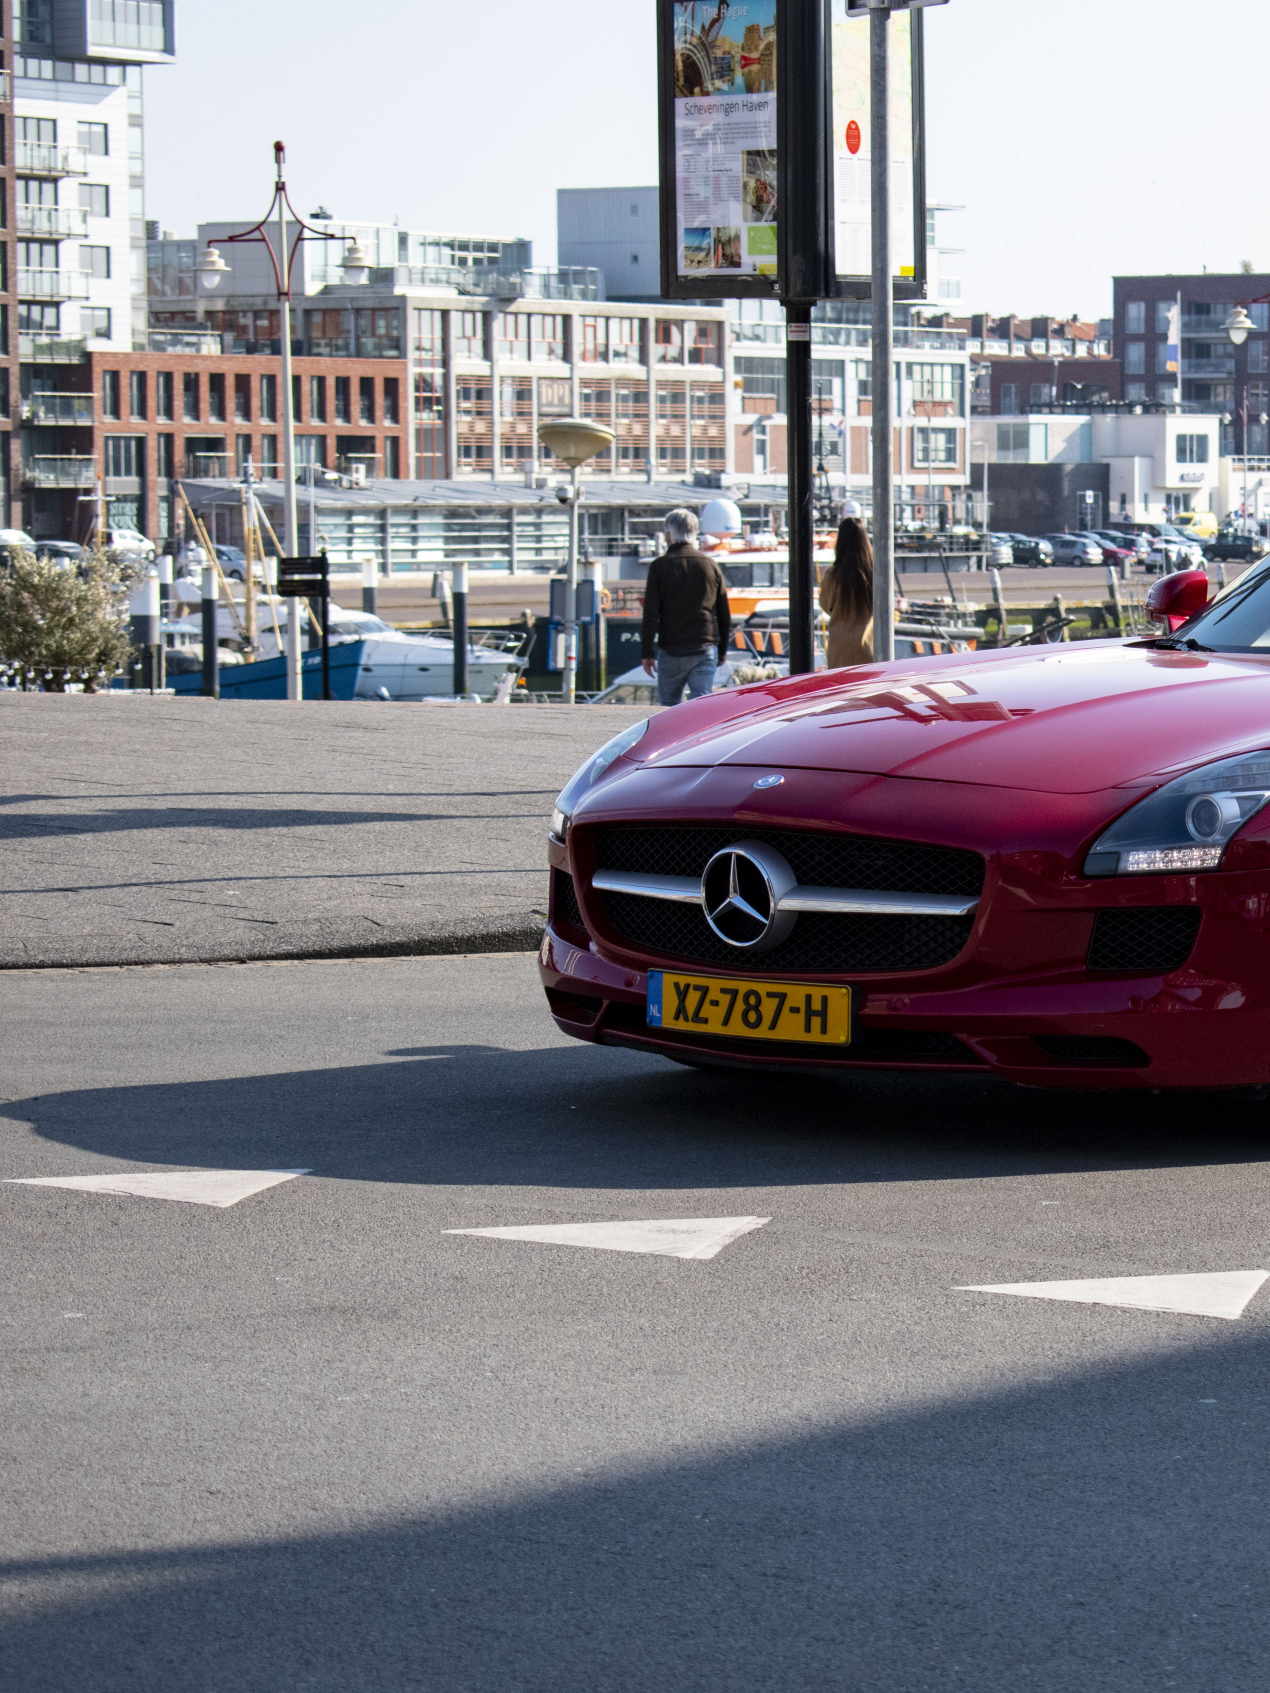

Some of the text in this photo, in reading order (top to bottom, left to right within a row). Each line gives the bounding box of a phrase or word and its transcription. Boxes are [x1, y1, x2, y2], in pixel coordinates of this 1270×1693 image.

[703, 5, 749, 20] The Hague
[684, 100, 769, 116] Scheveningen Haven
[650, 1004, 661, 1017] NL
[672, 981, 829, 1036] XZ-787-H
